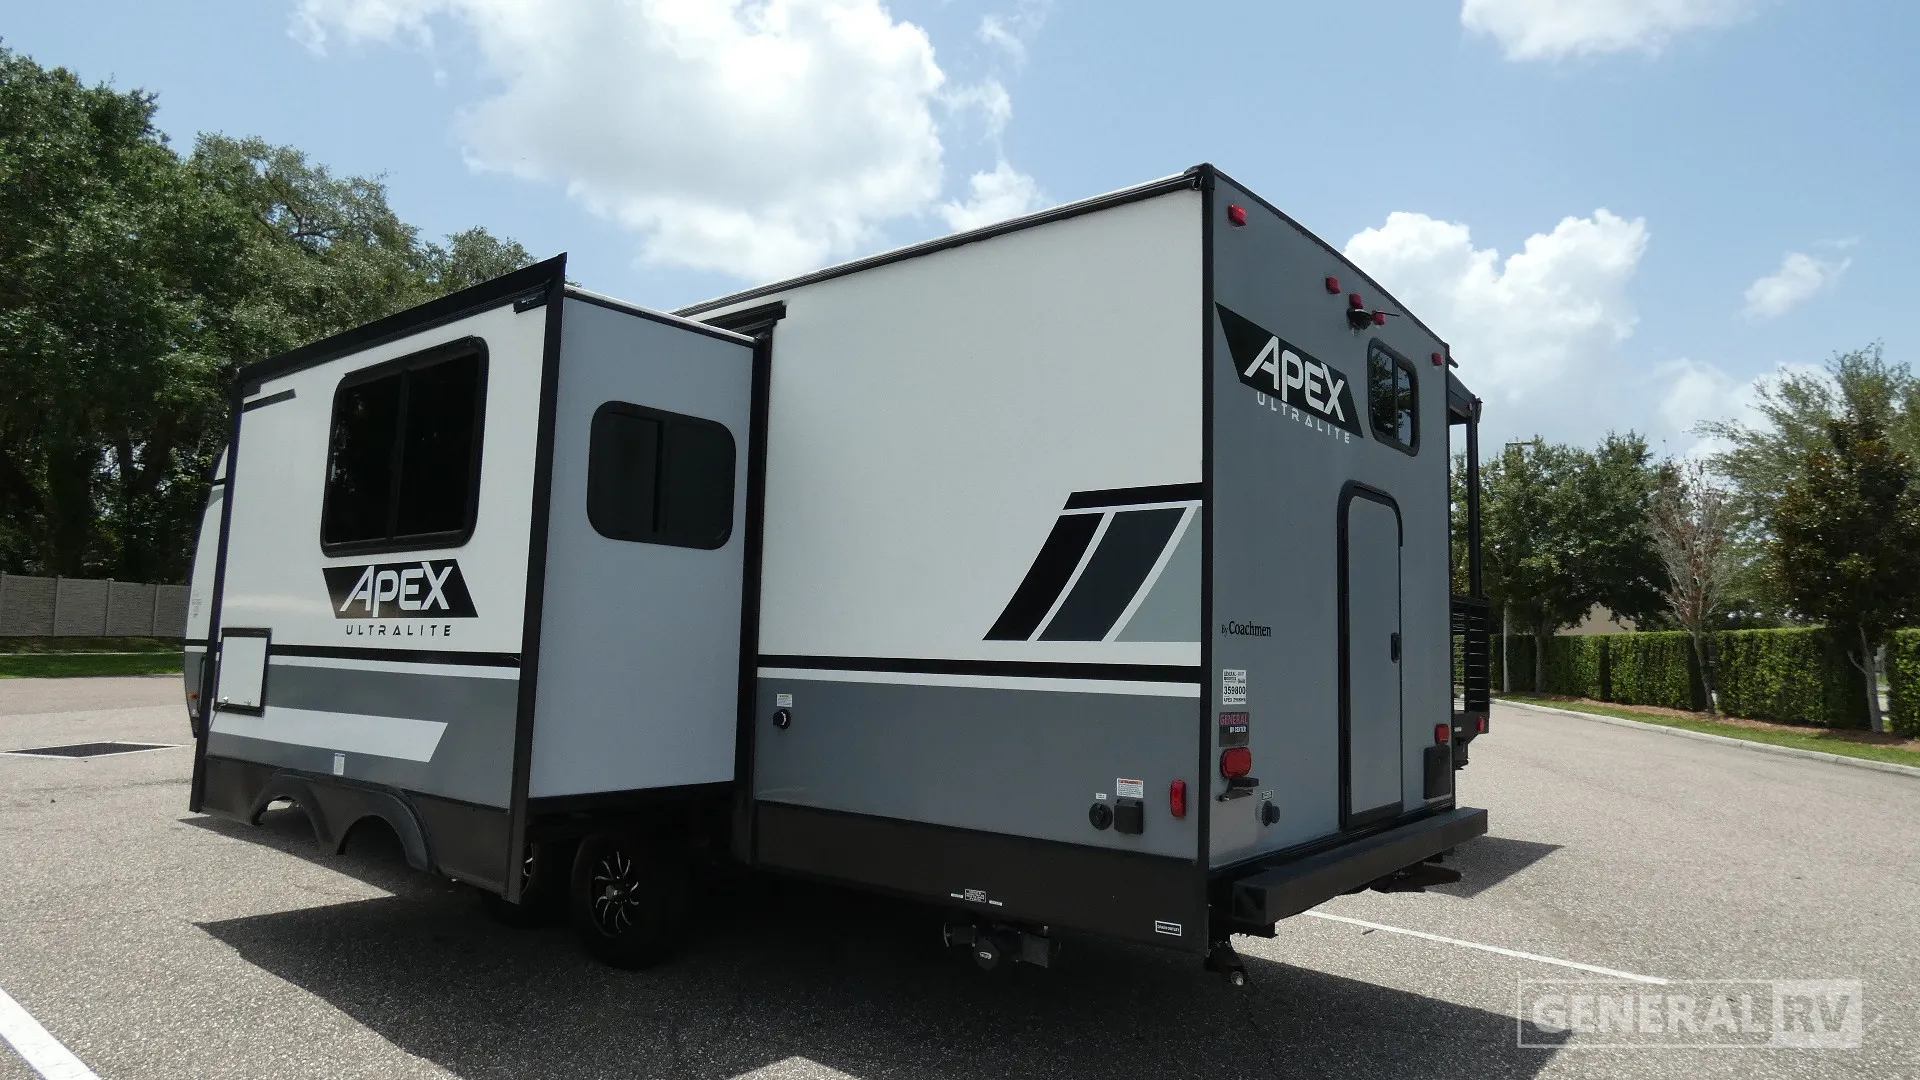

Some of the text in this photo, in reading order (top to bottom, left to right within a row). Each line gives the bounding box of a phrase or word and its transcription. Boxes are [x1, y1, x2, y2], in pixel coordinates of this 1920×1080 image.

[1244, 335, 1345, 422] APEX
[1257, 391, 1350, 444] ULTRALITE
[340, 561, 453, 618] APEX
[346, 624, 452, 637] ULTRALITE
[1228, 620, 1272, 637] Coachmen
